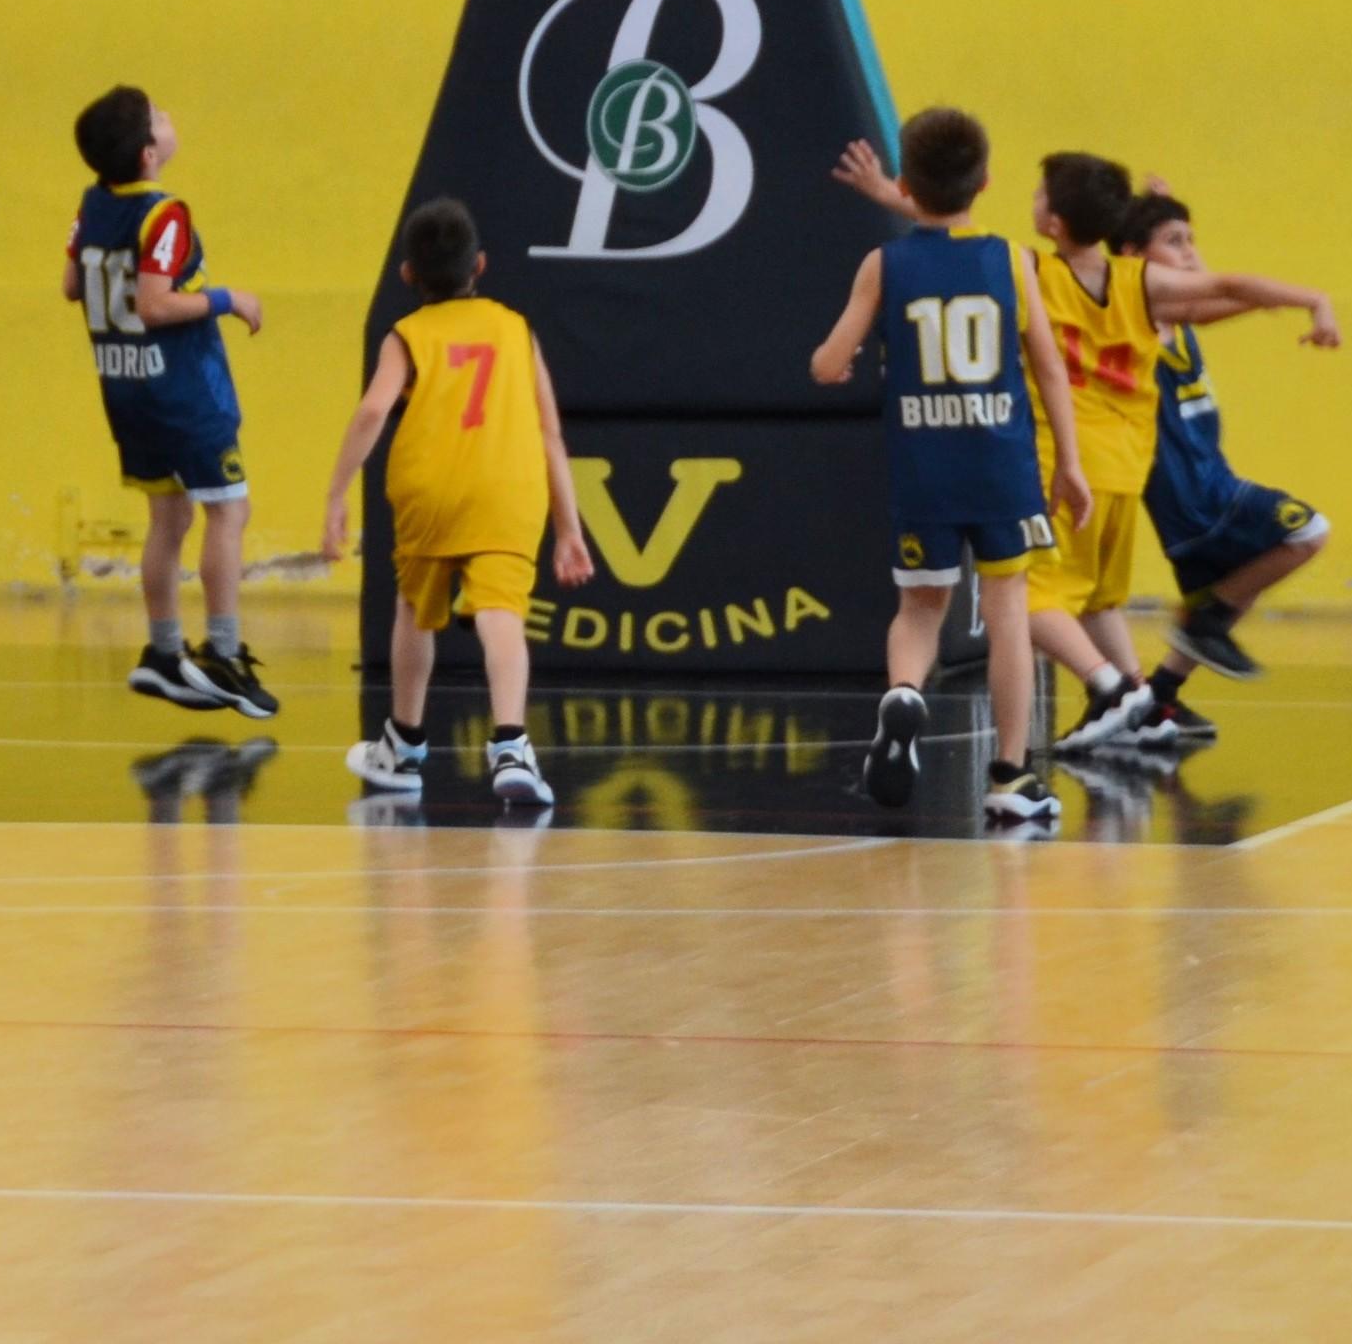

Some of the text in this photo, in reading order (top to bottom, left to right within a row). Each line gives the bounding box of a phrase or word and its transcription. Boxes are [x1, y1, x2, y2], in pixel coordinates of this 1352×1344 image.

[152, 219, 179, 272] 4
[80, 245, 146, 335] 16
[905, 294, 1002, 385] 10
[449, 344, 498, 430] 7
[901, 391, 1014, 429] BUDRIO
[570, 457, 742, 587] V
[1019, 512, 1055, 548] 10
[451, 586, 831, 653] EDICINA
